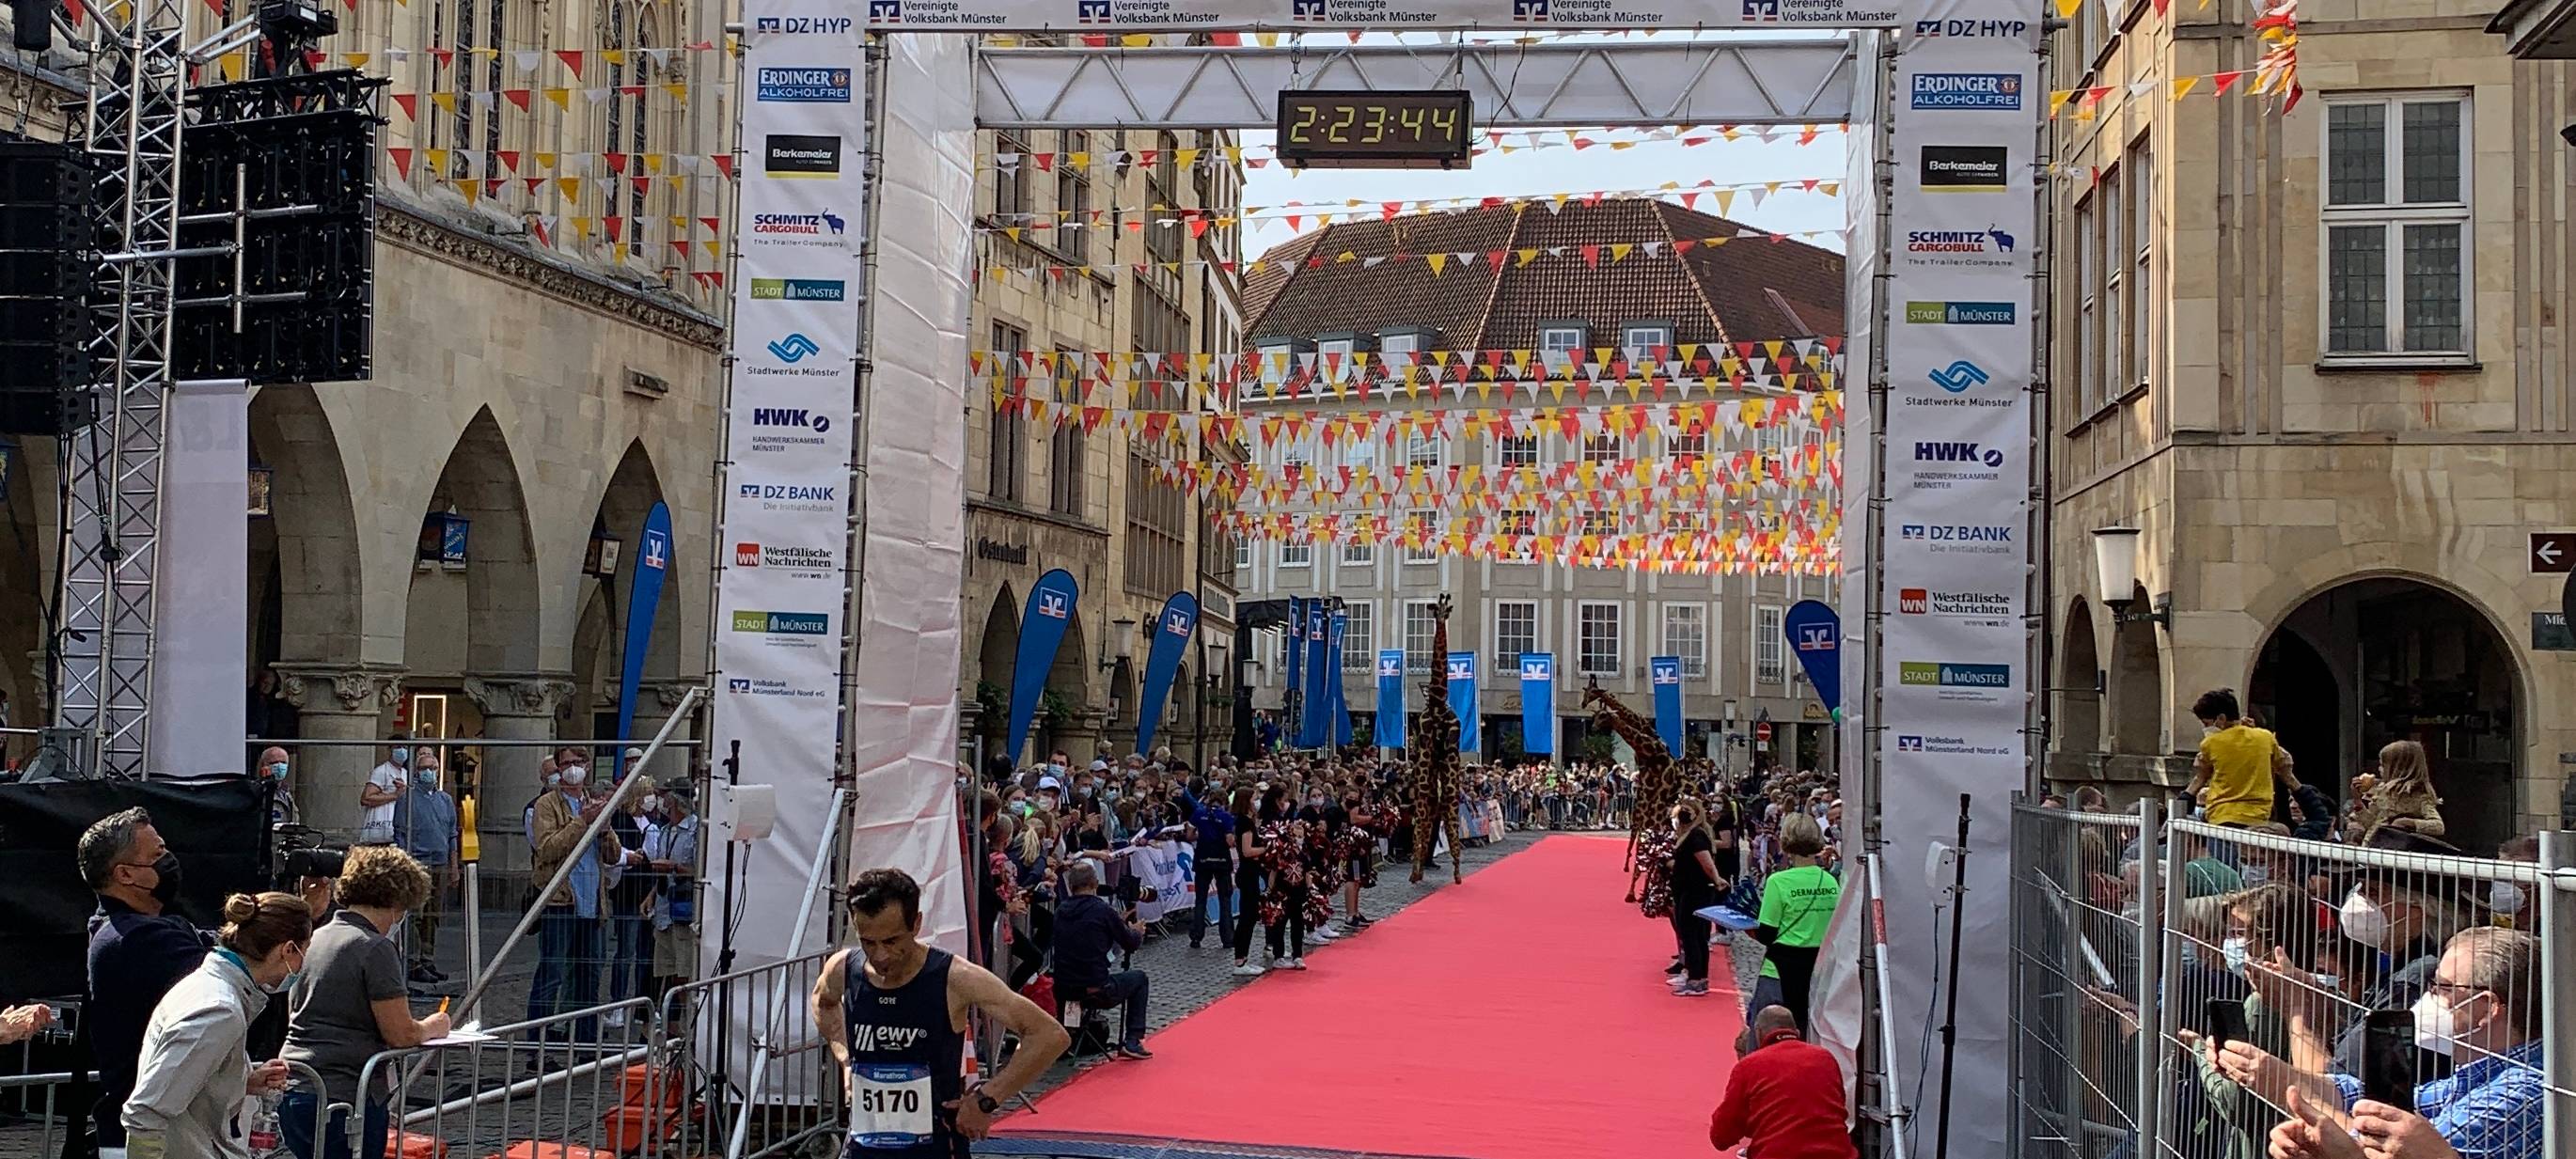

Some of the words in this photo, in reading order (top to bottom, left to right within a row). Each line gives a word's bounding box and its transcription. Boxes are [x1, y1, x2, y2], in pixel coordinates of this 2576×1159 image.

[904, 1, 958, 12] Vereinigte
[1114, 0, 1170, 12] Vereinigte
[904, 13, 958, 23] Volksbank
[961, 13, 1007, 23] Münster
[1114, 13, 1170, 23] Volksbank
[1172, 12, 1219, 23] Münster
[1328, 11, 1386, 22] Volksbank
[1389, 11, 1437, 22] Münster
[1551, 11, 1610, 23] Volksbank
[1614, 11, 1663, 22] Münster
[1782, 11, 1843, 22] Volksbank
[1846, 10, 1897, 21] Münster
[786, 18, 809, 34] DZ
[813, 18, 852, 34] HYP
[1948, 20, 1975, 37] DZ
[1981, 21, 2026, 38] HYP
[760, 70, 831, 86] ERDINGER
[1914, 75, 1999, 94] ERDINGER
[760, 87, 849, 98] ALKOHOLFREI
[1913, 94, 2018, 104] ALKOHOLFREI
[1290, 106, 1456, 143] 2:23:44
[754, 214, 819, 226] SCHMITZ
[754, 225, 819, 234] CARGOBULL
[1908, 231, 1985, 243] SCHMITZ
[1908, 243, 1985, 252] CARGOBULL
[753, 287, 782, 297] STADT
[797, 288, 840, 298] MÜNSTER
[1909, 310, 1942, 321] STADT
[1960, 309, 2011, 321] MÜNSTER
[746, 367, 799, 376] Stadtwerke
[802, 368, 840, 377] Münster
[1906, 397, 1966, 406] Stadtwerke
[1969, 398, 2013, 407] Münster
[753, 408, 809, 427] HWK
[752, 436, 825, 445] HANDWERKSKAMMER
[752, 444, 785, 452] MÜNSTER
[1915, 442, 1979, 462] HWK
[1914, 472, 1999, 480] HANDWERKSKAMMER
[764, 486, 786, 499] DZ
[789, 486, 835, 501] BANK
[763, 502, 778, 511] Die
[779, 503, 834, 512] Initiativbank
[1930, 525, 1954, 540] DZ
[1957, 526, 2012, 541] BANK
[764, 547, 833, 558] Westfälische
[1930, 543, 1945, 553] Die
[1949, 544, 2010, 554] Initiativbank
[737, 553, 759, 565] WN
[764, 556, 831, 568] Nachrichten
[1932, 592, 2010, 604] Westfälische
[1901, 599, 1925, 612] WN
[1932, 603, 2009, 615] Nachrichten
[736, 619, 765, 629] STADT
[780, 619, 824, 632] MÜNSTER
[1904, 672, 1937, 681] STADT
[1954, 671, 2004, 683] MÜNSTER
[752, 687, 795, 696] Münsterland
[797, 688, 814, 697] Nord
[1925, 745, 1974, 754] Münsterland
[1976, 746, 1996, 755] Nord
[878, 996, 897, 1005] GORE
[873, 1072, 906, 1080] Marathon
[862, 1089, 919, 1113] 5170
